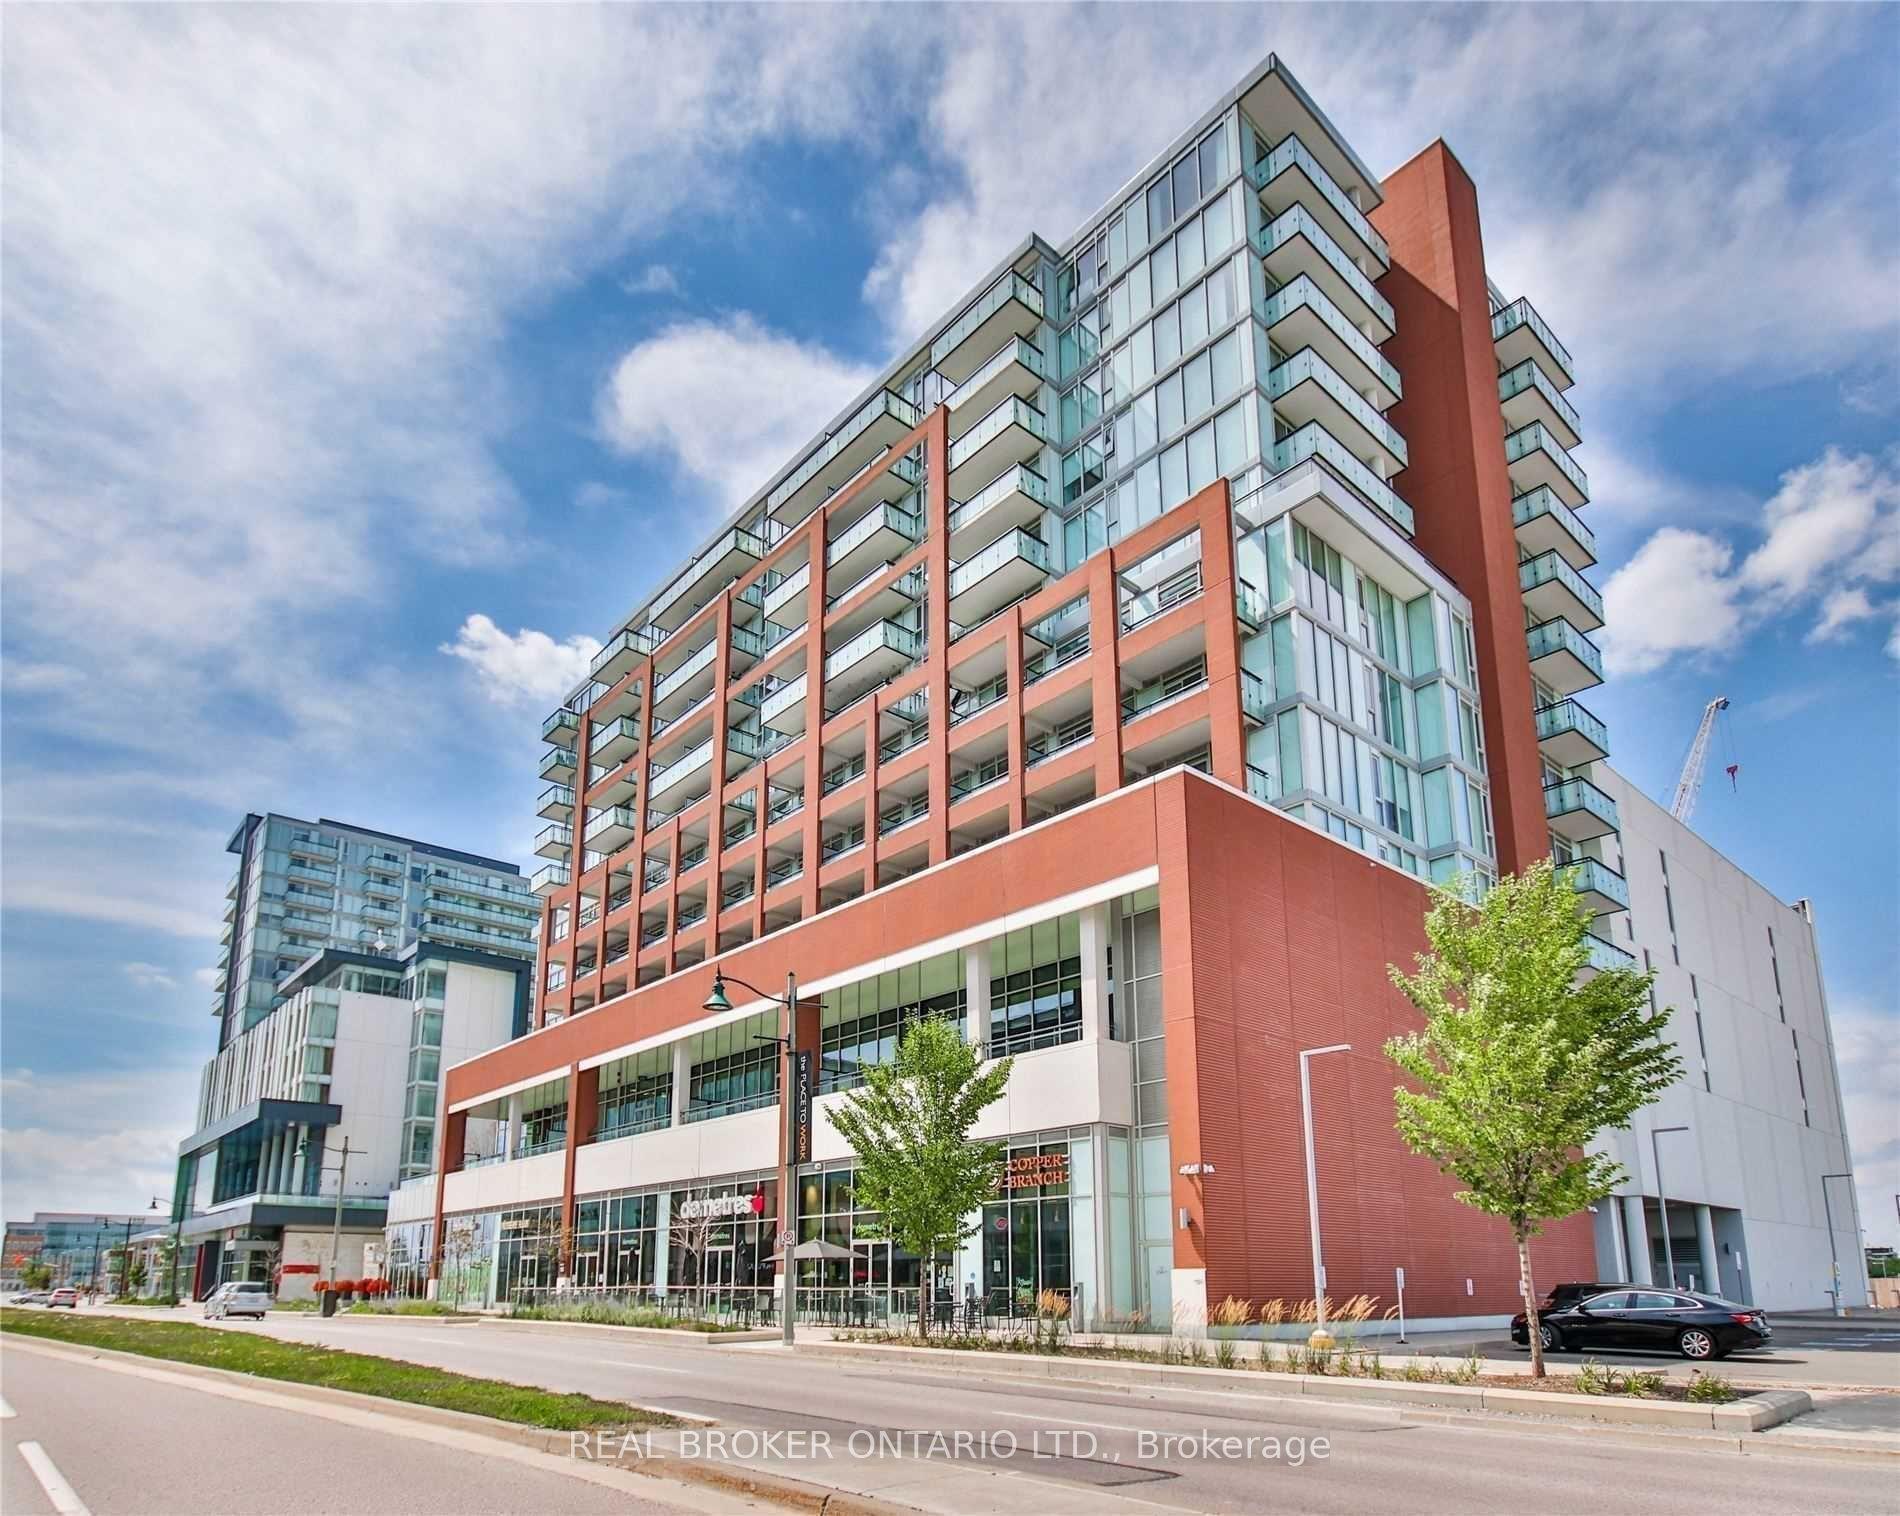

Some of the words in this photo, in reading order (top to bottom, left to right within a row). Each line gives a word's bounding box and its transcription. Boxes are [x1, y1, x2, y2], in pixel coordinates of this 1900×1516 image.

[799, 1055, 807, 1071] the
[799, 1073, 807, 1106] PLACE
[799, 1107, 807, 1124] TO
[799, 1124, 807, 1160] WORK
[1008, 1153, 1063, 1172] COPPER
[1008, 1170, 1064, 1189] BRANCH
[680, 1191, 752, 1219] demetres
